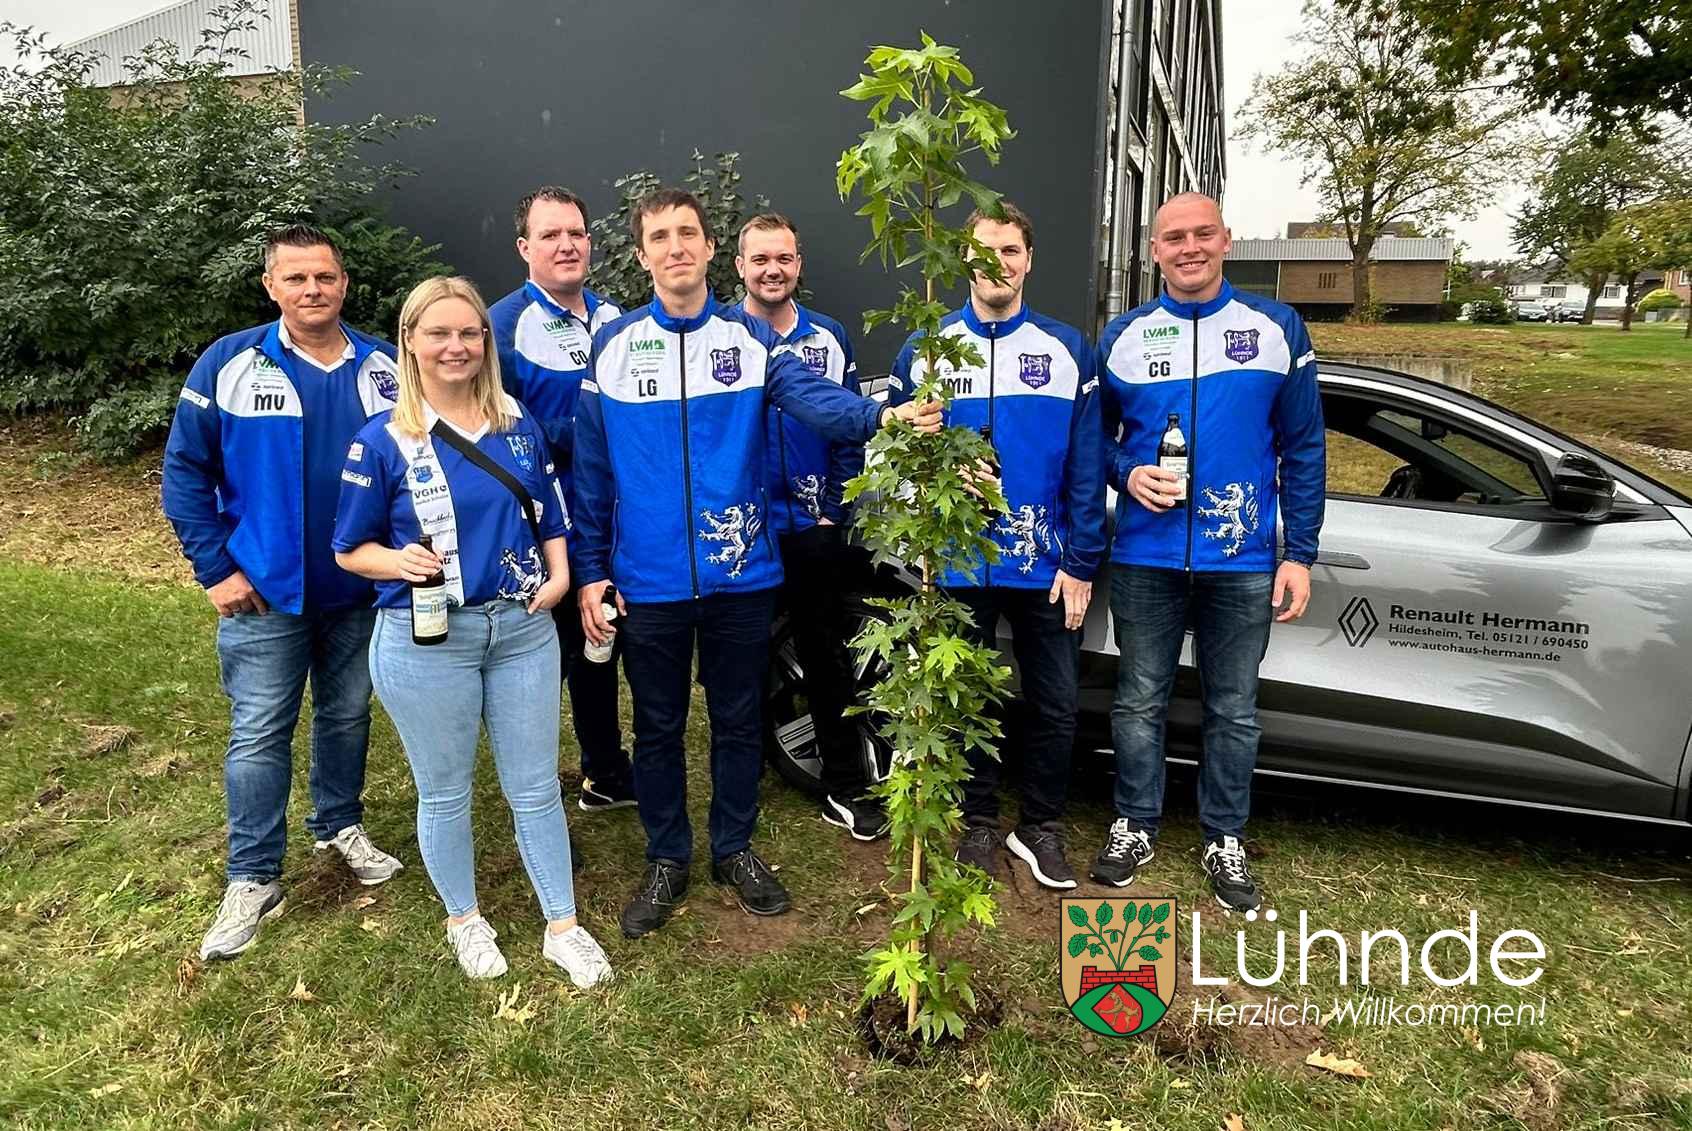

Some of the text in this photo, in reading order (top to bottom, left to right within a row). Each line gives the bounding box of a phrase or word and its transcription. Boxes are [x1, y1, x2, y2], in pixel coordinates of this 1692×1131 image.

[1143, 327, 1167, 338] LVM
[629, 339, 653, 352] LVM
[1149, 361, 1171, 378] CG
[638, 378, 657, 398] LG
[414, 486, 439, 499] VGH
[1390, 604, 1590, 634] Renault Hermann
[1388, 623, 1462, 640] Hildesheim,
[1466, 630, 1488, 641] Tel.
[1492, 632, 1528, 644] 05121
[1542, 636, 1589, 649] 690450
[1388, 639, 1561, 661] www.autohaus-hermann.de
